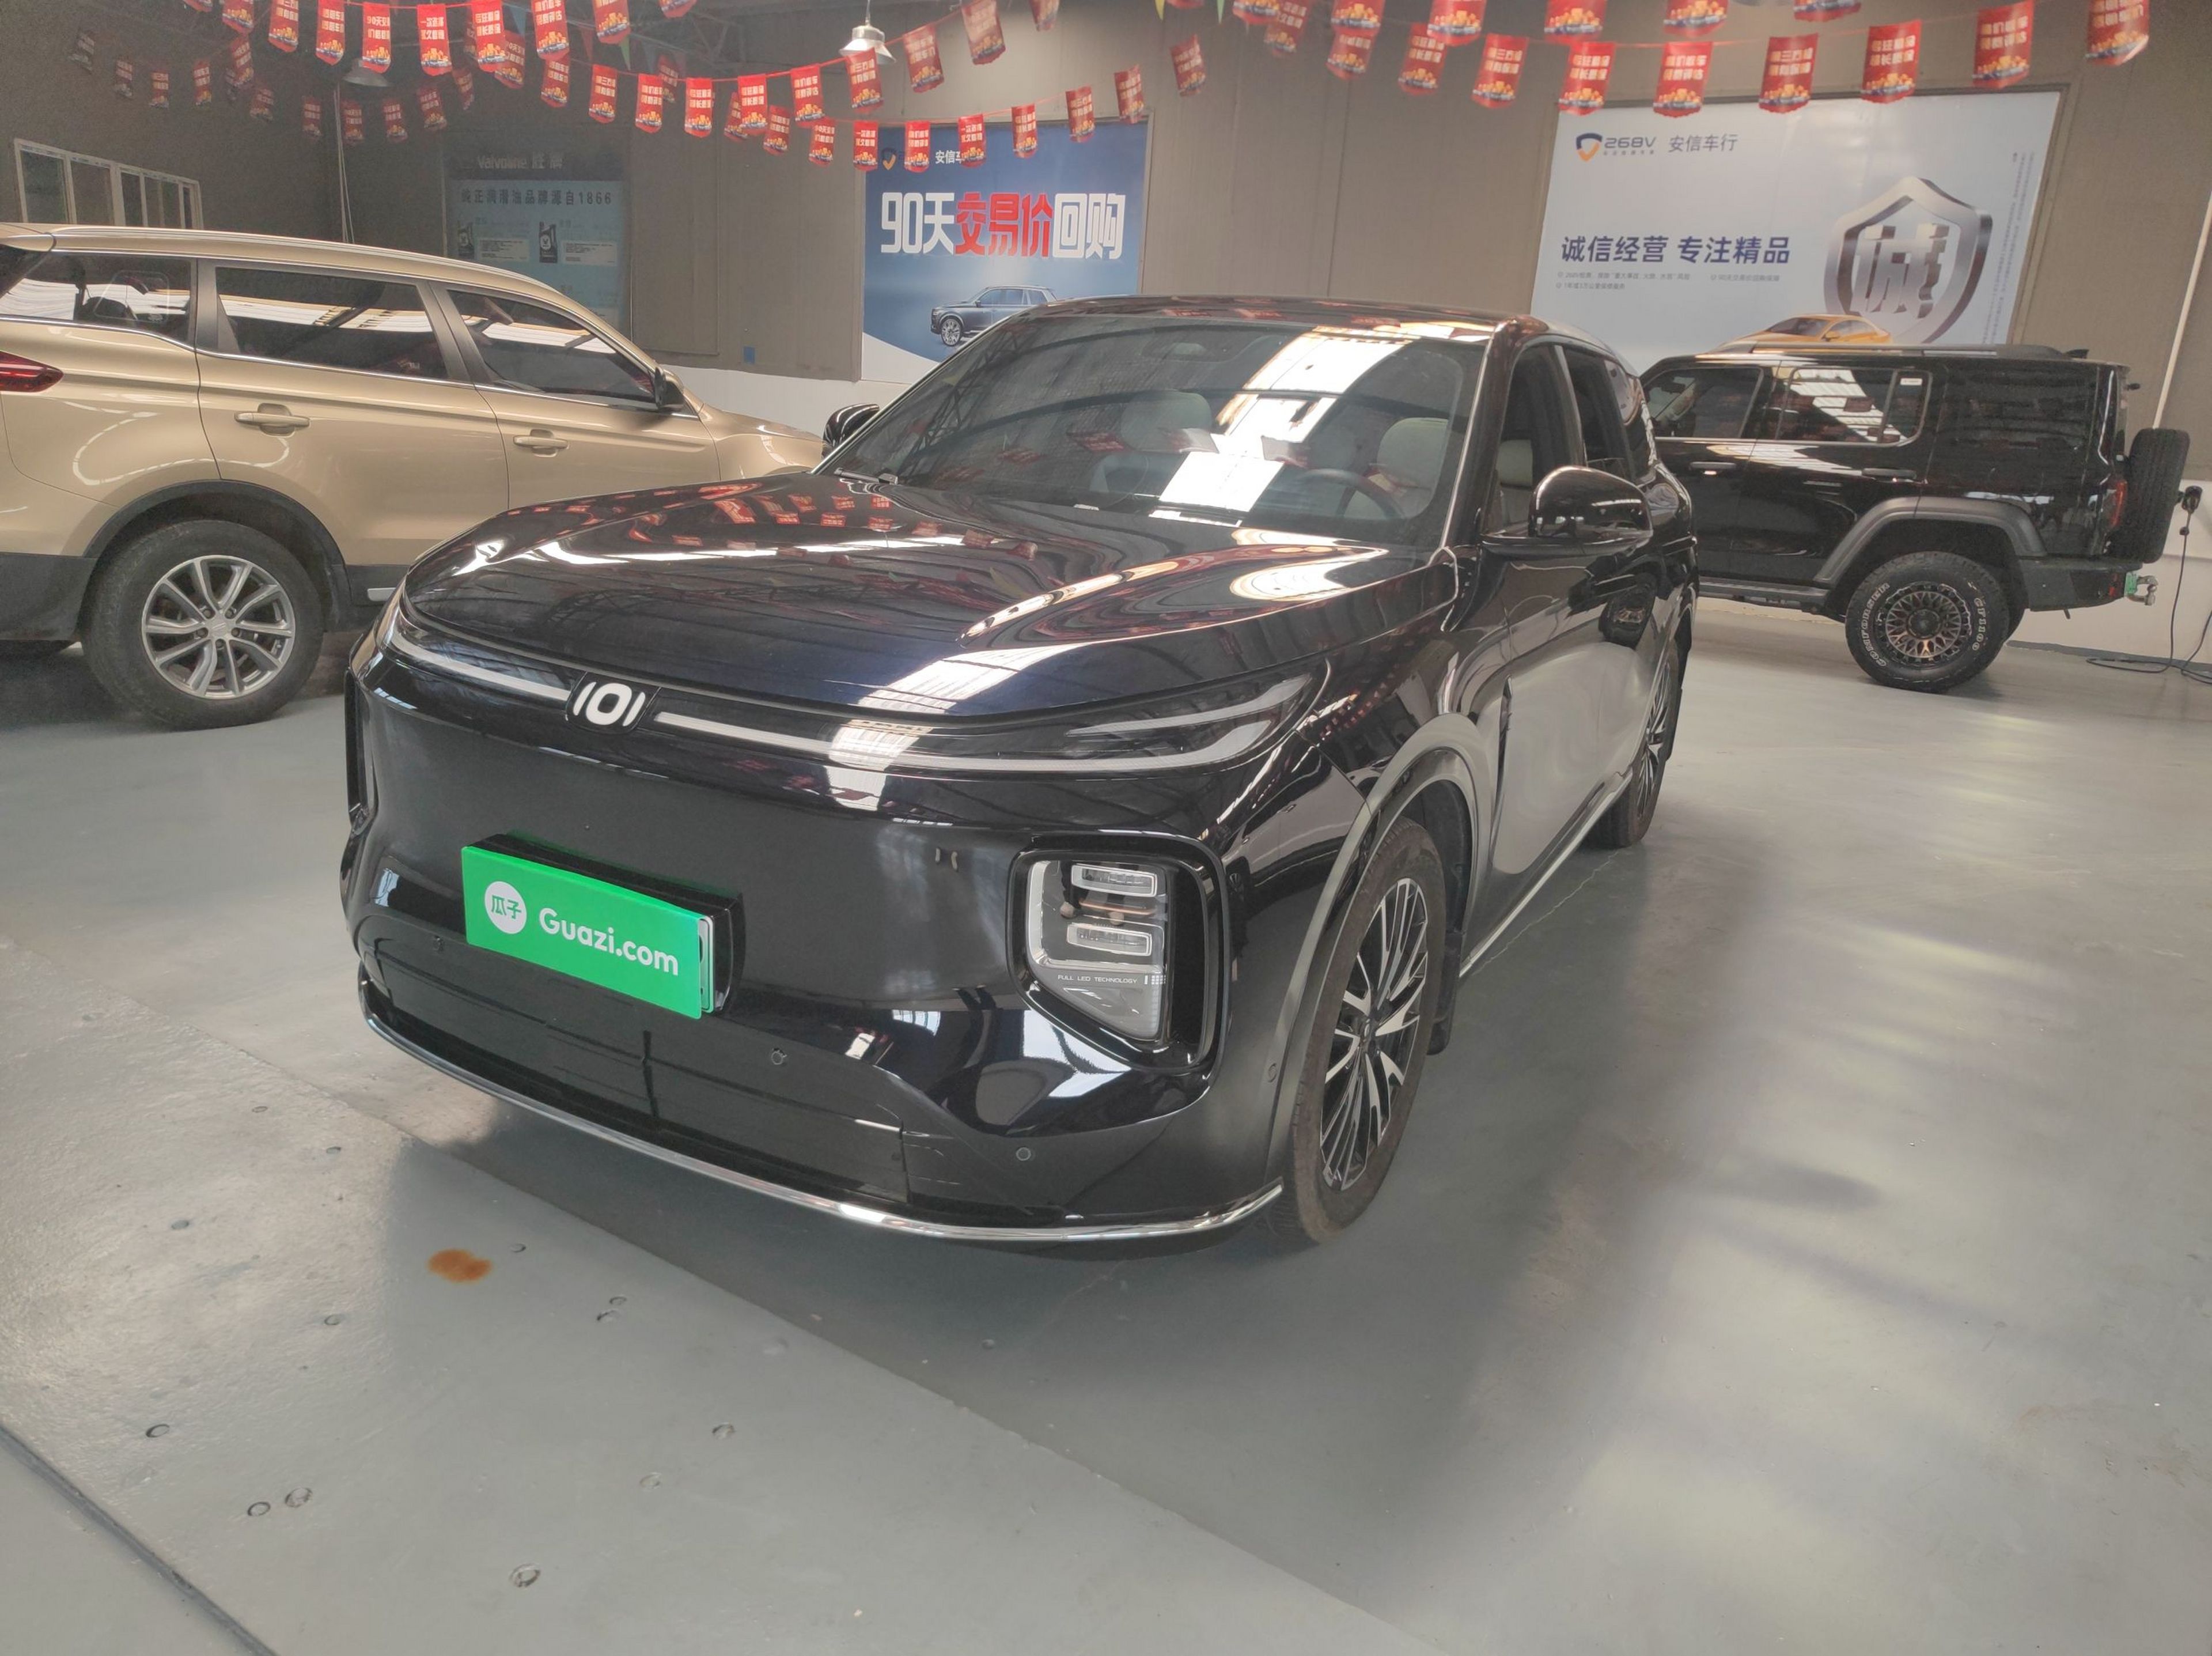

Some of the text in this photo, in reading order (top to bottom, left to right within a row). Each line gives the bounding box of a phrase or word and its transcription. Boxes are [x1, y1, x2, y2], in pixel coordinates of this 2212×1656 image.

[1604, 136, 1657, 149] 268V
[1668, 134, 1738, 153] 安信车行
[880, 191, 1127, 260] 90天交易价回购
[1561, 235, 1790, 264] 诚信经营 专注精品
[491, 894, 521, 920] 瓜子
[539, 908, 679, 976] Guazi.com
[1094, 976, 1138, 984] TECHNOLOGY
